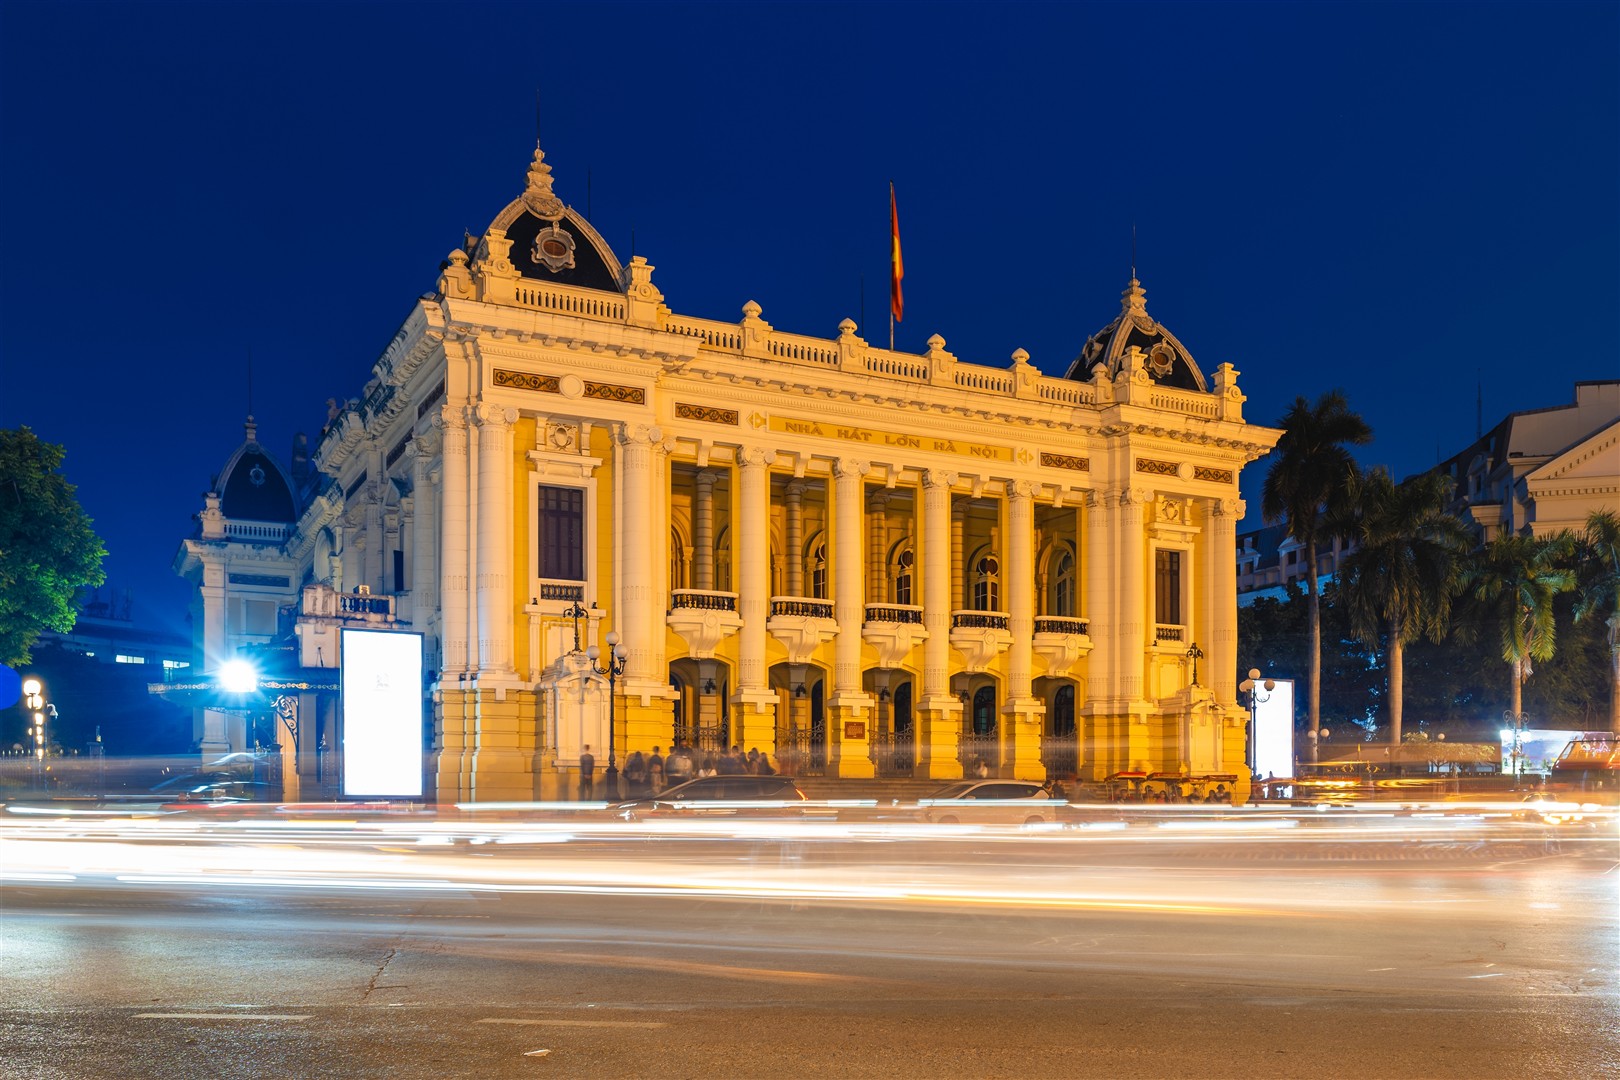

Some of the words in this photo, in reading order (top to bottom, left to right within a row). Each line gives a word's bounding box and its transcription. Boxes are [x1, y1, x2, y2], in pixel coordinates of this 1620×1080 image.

[785, 421, 824, 435] NHÀ
[837, 427, 872, 441] HÁT
[933, 440, 957, 453] HÀ
[970, 445, 998, 459] NỘI
